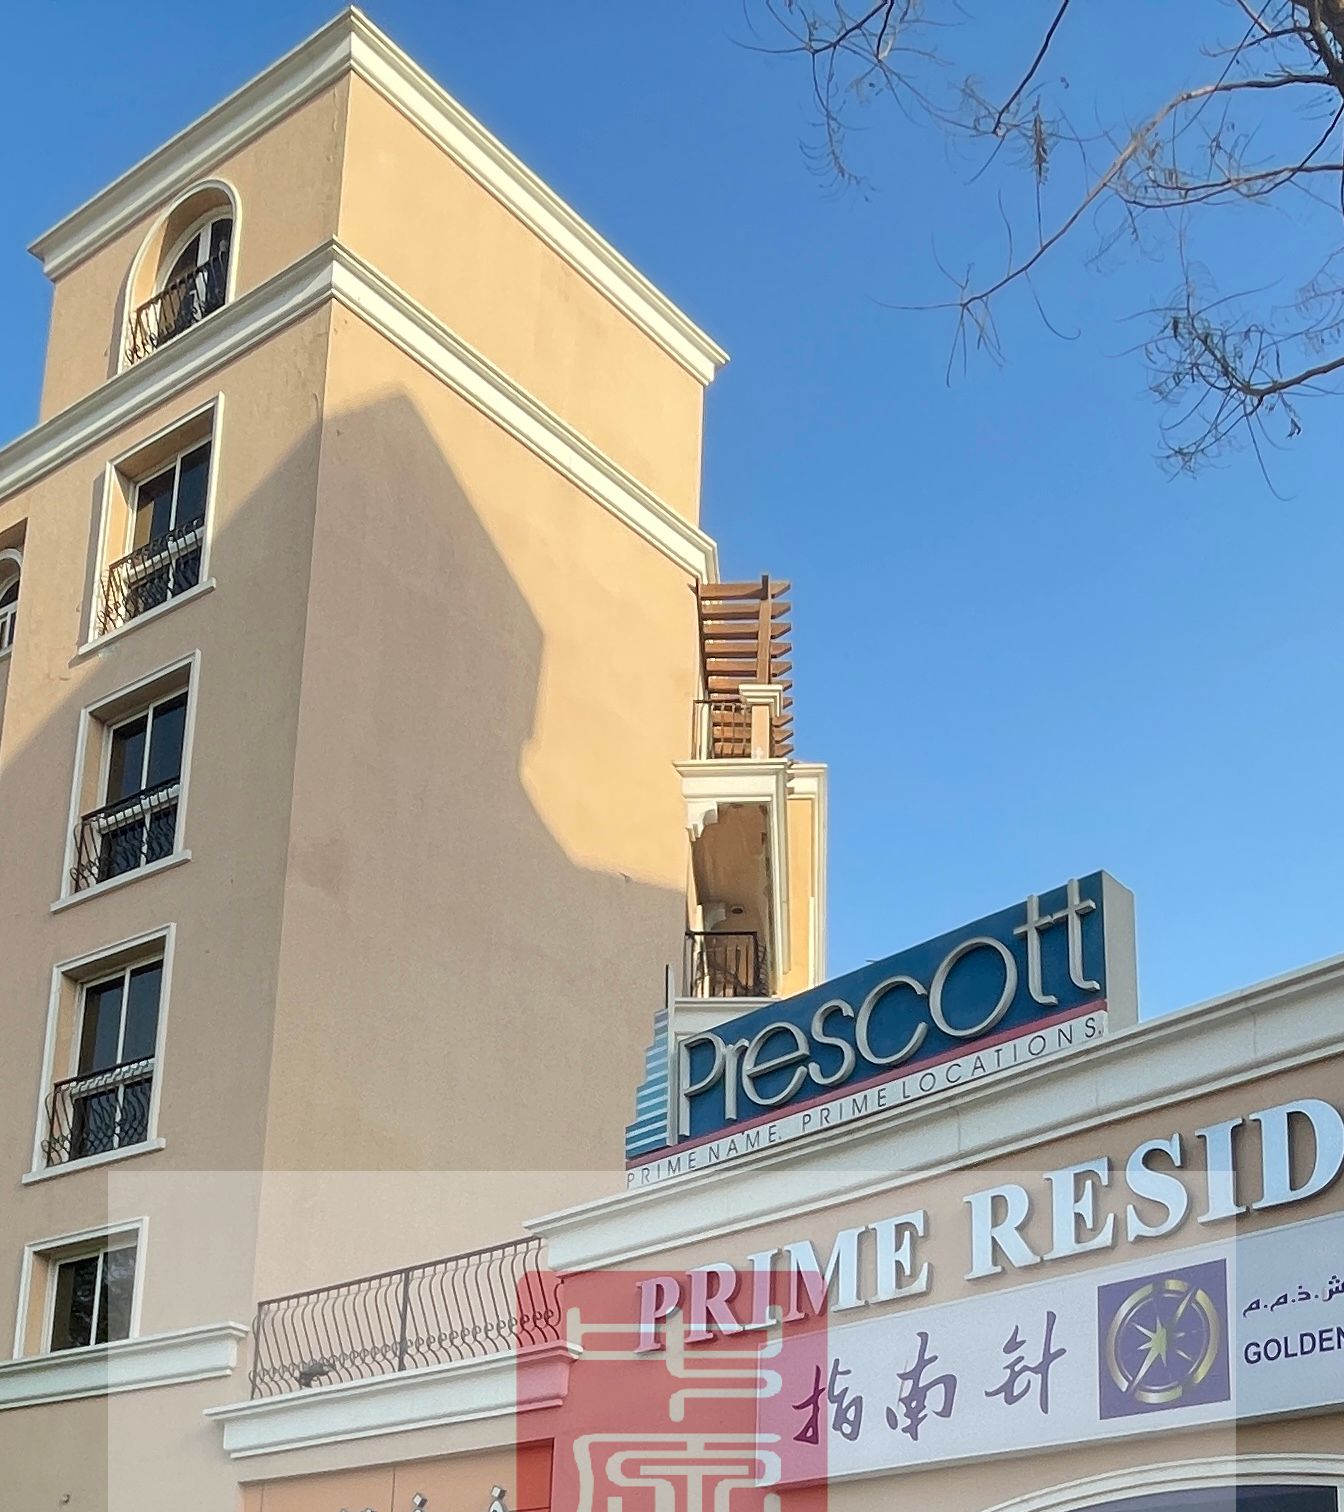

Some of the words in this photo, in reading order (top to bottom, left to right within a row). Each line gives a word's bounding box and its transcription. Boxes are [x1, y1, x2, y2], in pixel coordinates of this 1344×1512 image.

[678, 878, 1101, 1137] Prescott
[626, 1150, 697, 1189] PRIME
[802, 1087, 887, 1131] PRIME
[634, 1208, 930, 1354] PRIME
